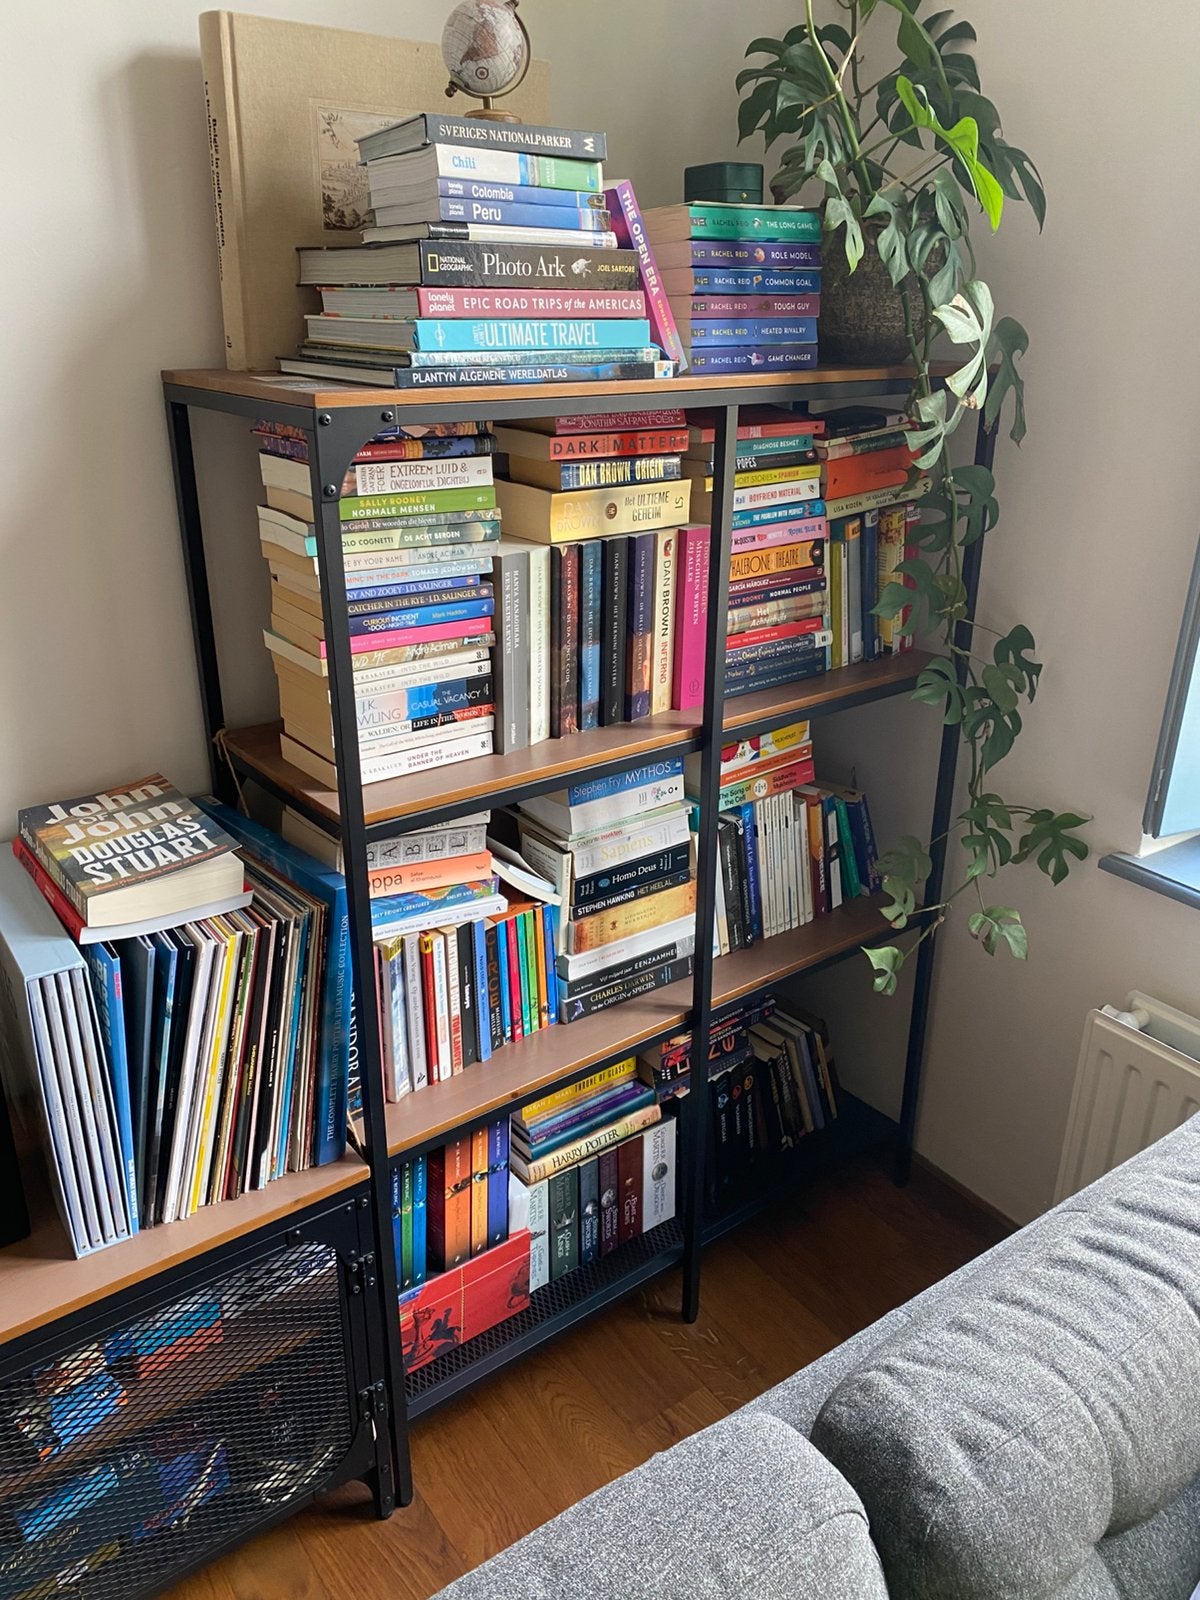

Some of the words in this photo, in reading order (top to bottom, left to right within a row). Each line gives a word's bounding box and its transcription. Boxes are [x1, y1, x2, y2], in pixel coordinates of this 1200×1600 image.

[440, 125, 488, 140] SVERIGES
[490, 130, 572, 148] NATIONALPARKER
[452, 156, 476, 169] Chili
[472, 185, 514, 200] Colombia
[472, 204, 502, 220] Peru
[779, 222, 796, 230] LONG
[797, 222, 814, 230] GAME
[623, 191, 636, 222] THE
[632, 224, 650, 264] OPEN
[645, 268, 660, 296] ERA
[440, 256, 466, 264] NATIONAL
[711, 250, 734, 258] RACHEL
[790, 252, 812, 260] MODEL
[440, 263, 474, 272] GEOGRAPHIC
[482, 253, 532, 277] Photo
[534, 256, 566, 278] Ark
[597, 264, 610, 272] JOEL
[611, 265, 635, 273] SARTORE
[765, 278, 793, 286] COMMON
[794, 278, 812, 287] GOAL
[428, 292, 454, 304] lonely
[464, 298, 490, 310] EPIC
[495, 298, 528, 309] ROAD
[533, 298, 562, 309] TRIPS
[574, 298, 586, 309] the
[588, 300, 642, 310] AMERICAS
[428, 302, 456, 313] planet
[774, 302, 794, 311] TOUGH
[795, 303, 810, 311] GUY
[484, 323, 548, 347] ULTIMATE
[552, 322, 598, 346] TRAVEL
[712, 328, 734, 336] RACHEL
[768, 354, 784, 362] GAME
[785, 354, 811, 362] CHANGER
[412, 372, 457, 384] PLANTYN
[460, 370, 508, 382] ALGEMENE
[509, 368, 568, 380] WERELDATLAS
[578, 418, 616, 429] JONATHAN
[618, 416, 647, 426] SAFRAN
[650, 414, 675, 425] FOER
[554, 441, 599, 456] DARK
[613, 436, 676, 451] MATTER
[752, 442, 780, 451] DIAGNOSE
[780, 440, 800, 448] BESMET
[390, 464, 432, 478] EXTREEM
[435, 462, 458, 474] LUID
[736, 457, 756, 470] POPES
[377, 466, 385, 492] FOER
[580, 464, 598, 486] DAN
[600, 461, 631, 484] BROWN
[635, 458, 665, 480] ORIGIN
[778, 470, 800, 479] SPANISH
[360, 498, 387, 508] SALLY
[388, 496, 427, 505] ROONEY
[638, 490, 670, 506] ULTIEME
[749, 489, 778, 502] BOYFRIEND
[778, 487, 802, 498] MATERIAL
[352, 508, 396, 517] NORMALE
[400, 504, 436, 514] MENSEN
[632, 507, 662, 522] GEHEIM
[834, 504, 845, 513] LISA
[382, 519, 408, 528] woorden
[359, 538, 394, 546] COGNETTI
[414, 533, 432, 542] ACHT
[364, 556, 382, 565] YOUR
[775, 548, 800, 568] THEATRE
[412, 568, 439, 576] TOMASZ
[662, 560, 671, 587] DAN
[360, 590, 377, 598] AND
[378, 587, 401, 596] ZOOEY
[418, 580, 453, 592] SALINGER
[770, 588, 792, 598] NORMAL
[793, 584, 811, 593] PEOPLE
[348, 603, 384, 614] CATCHER
[396, 599, 410, 608] THE
[411, 597, 424, 606] RYE
[442, 590, 478, 600] SALINGER
[363, 616, 390, 626] CURIOUS
[392, 612, 419, 621] INCIDENT
[661, 589, 671, 637] BROWN
[757, 608, 770, 618] Het
[430, 640, 459, 652] Aciman
[504, 624, 512, 654] LEVEN
[402, 665, 418, 674] INTO
[660, 641, 668, 684] INFERNO
[412, 698, 442, 710] CASUAL
[444, 690, 481, 704] VACANCY
[414, 719, 430, 728] LIFE
[442, 714, 455, 724] THE
[408, 752, 429, 762] UNDER
[431, 749, 442, 757] THE
[408, 759, 434, 768] BANNER
[446, 749, 470, 759] HEAVEN
[574, 782, 607, 798] Stephen
[609, 778, 620, 788] Fry
[625, 762, 672, 784] MYTHOS
[730, 787, 744, 798] Song
[45, 784, 164, 825] John
[736, 797, 746, 808] Cell
[62, 801, 185, 845] John
[79, 814, 110, 824] OF
[68, 814, 200, 866] DOUGLAS
[601, 836, 653, 860] Sapiens
[83, 829, 218, 886] STUART
[612, 871, 637, 884] Homo
[638, 864, 656, 875] Deus
[578, 900, 606, 916] STEPHEN
[606, 890, 635, 906] HAWKING
[637, 887, 648, 896] HET
[650, 879, 672, 892] HEELAL
[338, 914, 349, 969] COLLECTION
[408, 942, 416, 962] Ocean
[410, 963, 418, 983] Vuong
[336, 969, 345, 996] MUSIC
[590, 984, 623, 1002] CHARLES
[624, 972, 654, 990] DARWIN
[604, 992, 627, 1006] ORIGIN
[632, 980, 656, 994] SPECIES
[450, 1014, 460, 1034] TOM
[452, 1036, 462, 1068] LANOYE
[574, 1078, 597, 1093] THRONE
[599, 1072, 606, 1082] OF
[608, 1063, 626, 1078] GLASS
[328, 1080, 338, 1123] COMPLETE
[552, 1145, 584, 1168] HARRY
[584, 1128, 620, 1152] POTTER
